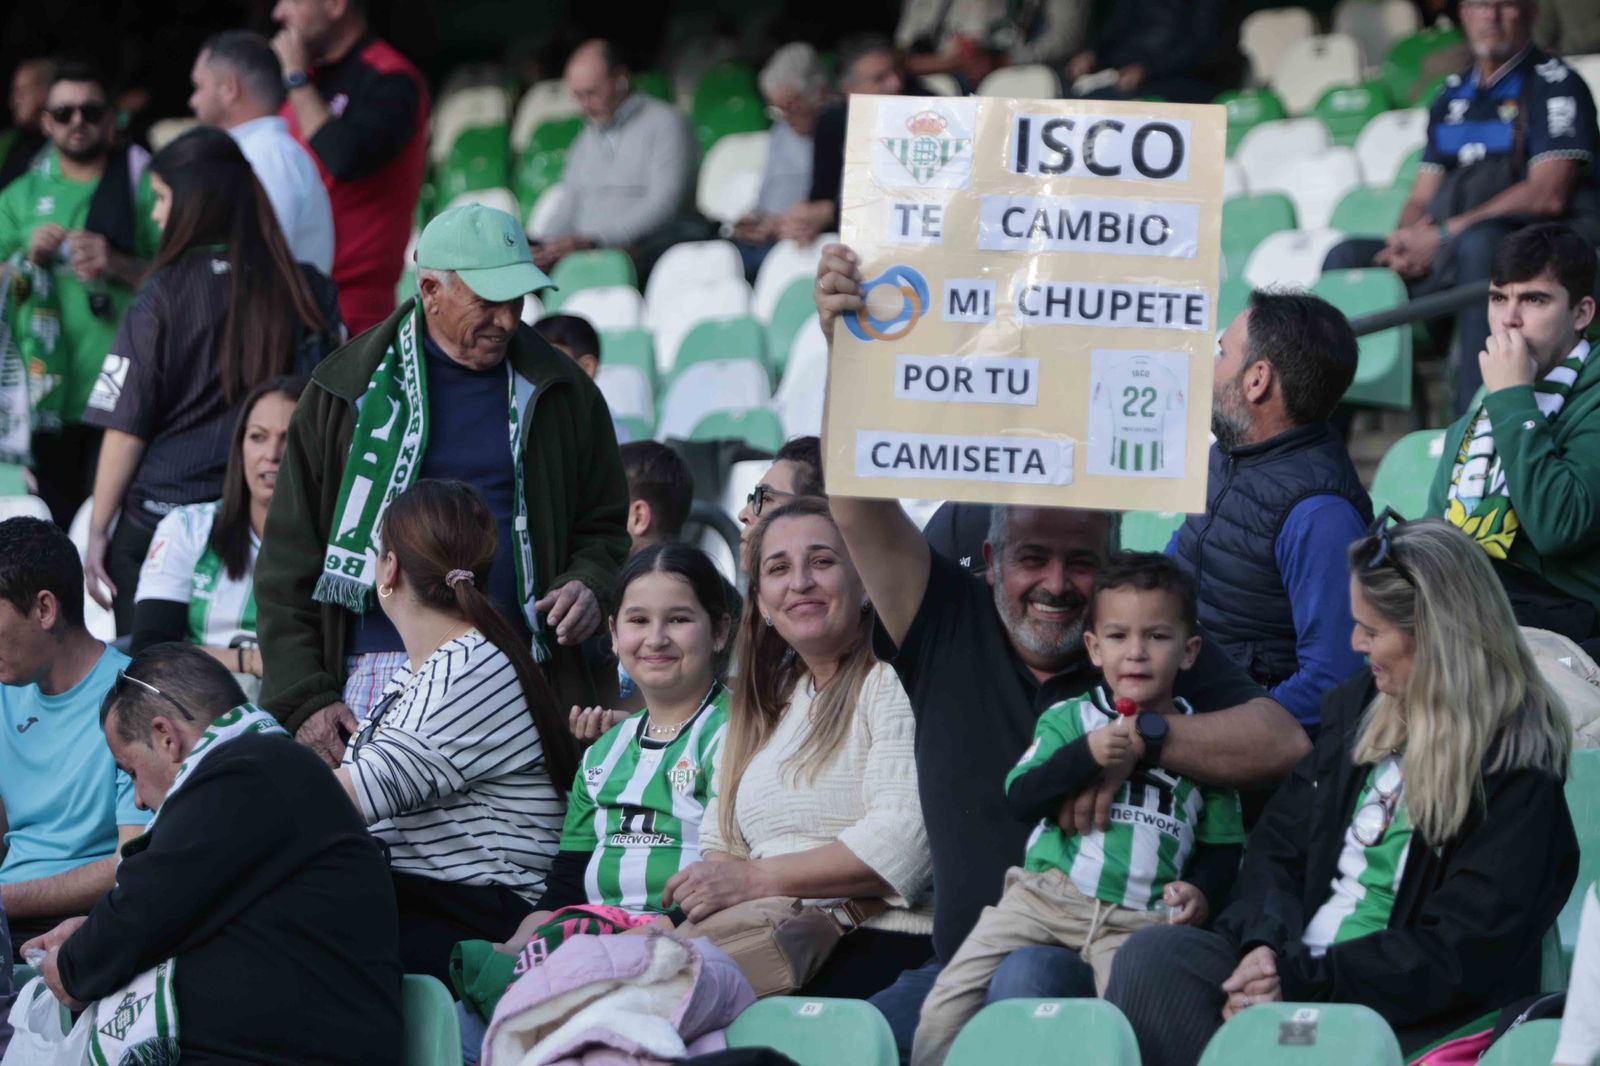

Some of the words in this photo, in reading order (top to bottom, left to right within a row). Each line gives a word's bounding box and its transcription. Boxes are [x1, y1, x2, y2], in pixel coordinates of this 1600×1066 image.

[1016, 117, 1185, 179] ISCO
[895, 203, 942, 237] TE
[1001, 206, 1170, 246] CAMBIO
[949, 288, 990, 316] MI
[1018, 285, 1204, 326] CHUPETE
[904, 364, 974, 393] POR
[985, 368, 1030, 395] TU
[1122, 386, 1158, 418] 22
[871, 441, 1046, 476] CAMISETA
[1110, 806, 1181, 838] network
[611, 833, 674, 845] network
